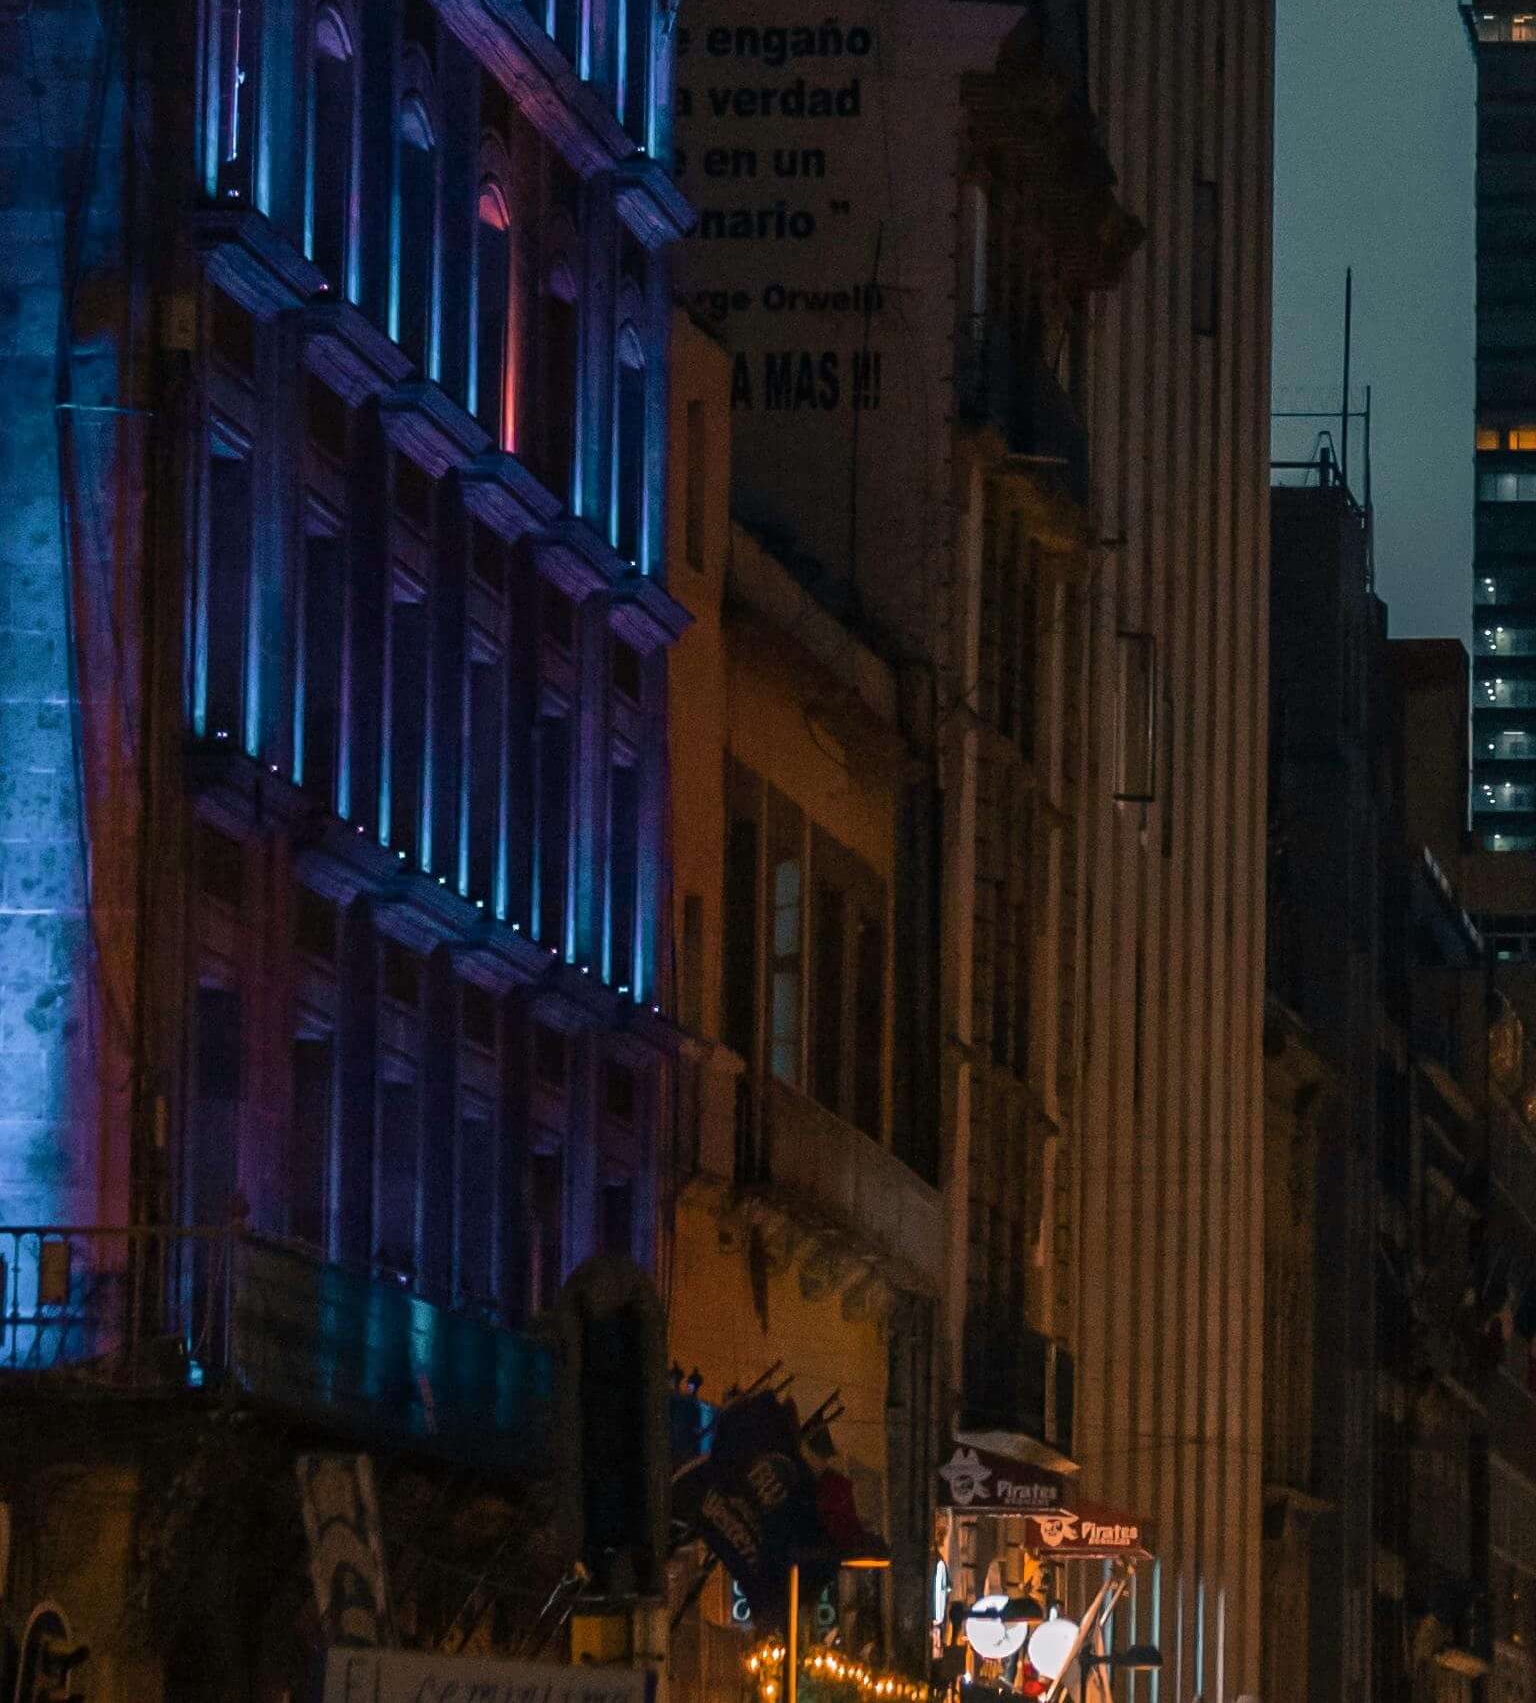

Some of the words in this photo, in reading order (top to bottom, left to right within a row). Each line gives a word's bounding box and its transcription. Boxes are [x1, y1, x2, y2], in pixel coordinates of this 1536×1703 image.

[706, 16, 872, 66] engaño
[708, 78, 861, 117] verdad
[704, 147, 757, 178] en
[773, 147, 826, 178] un
[685, 200, 816, 239] nario
[765, 350, 841, 411] MAS
[1081, 1521, 1139, 1540] Pirates
